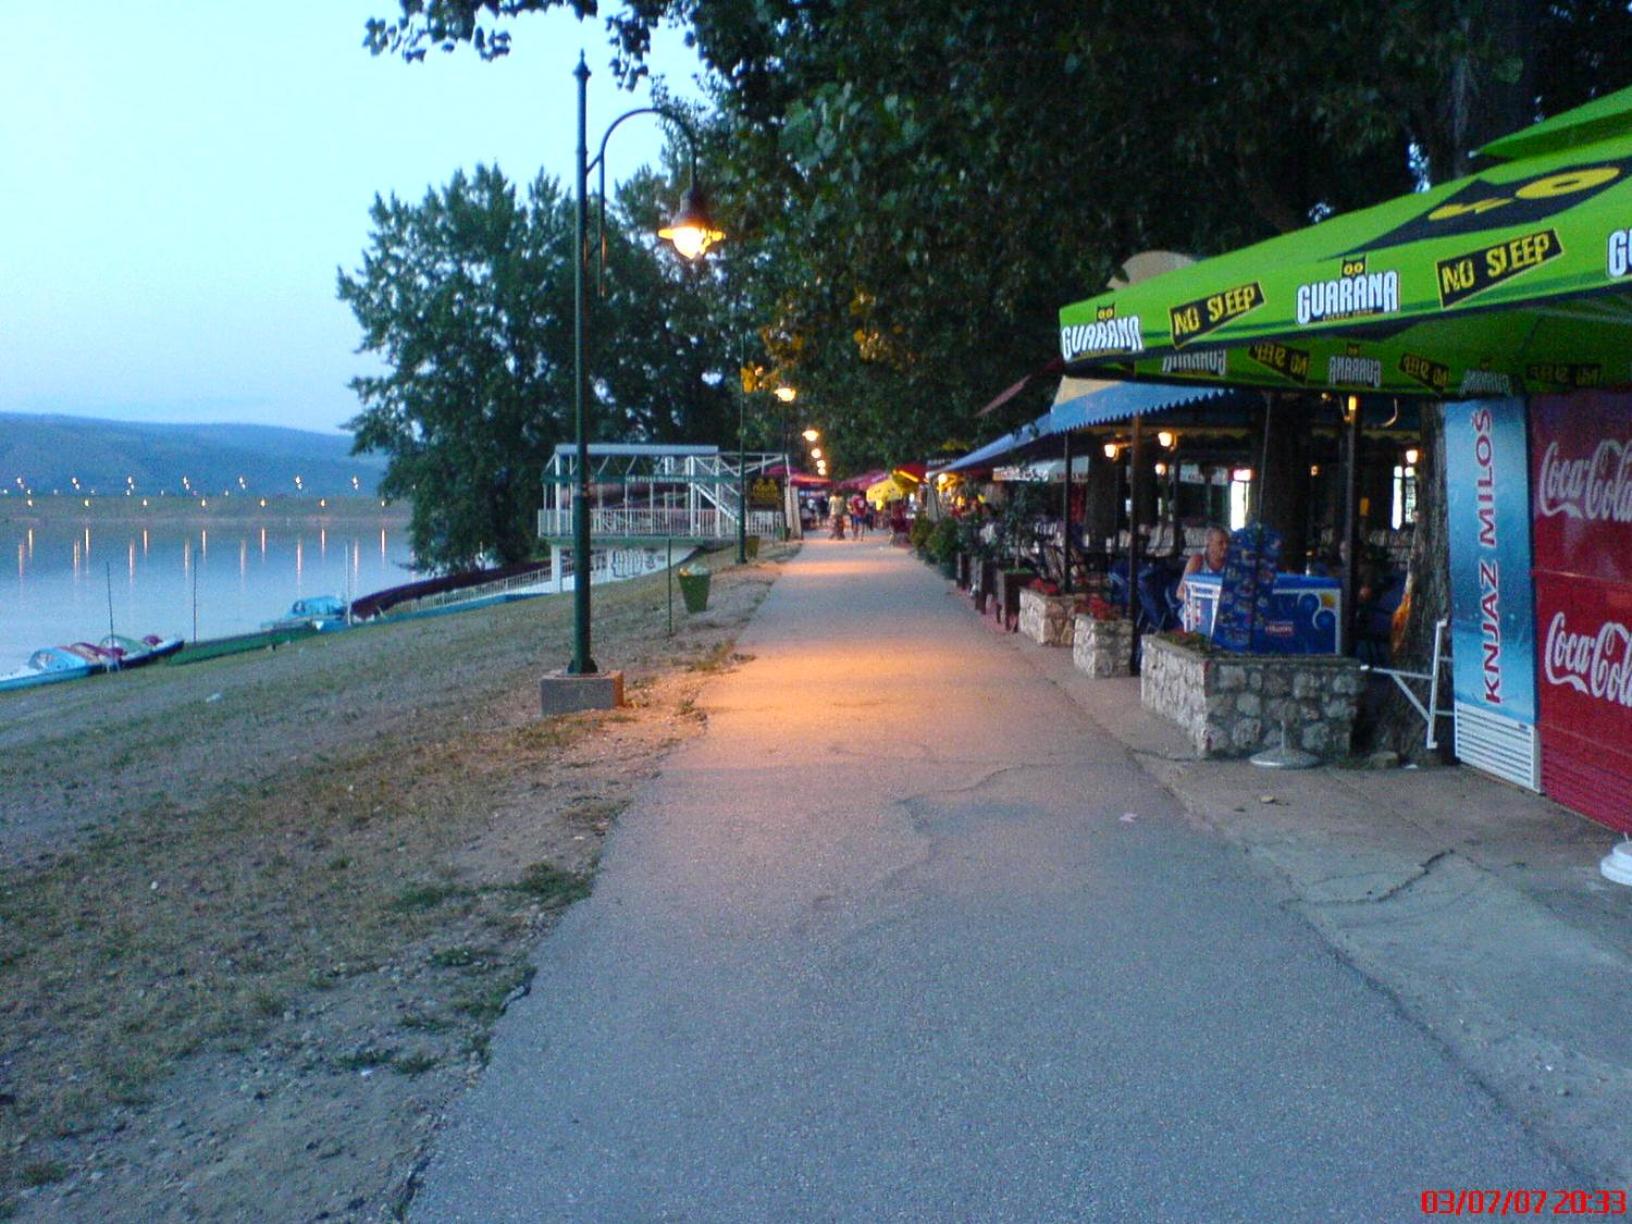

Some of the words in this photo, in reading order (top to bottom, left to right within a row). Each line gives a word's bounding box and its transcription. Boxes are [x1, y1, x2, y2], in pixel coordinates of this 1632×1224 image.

[1442, 259, 1475, 294] NO
[1486, 232, 1550, 278] SLEEP
[1173, 306, 1200, 336] NO
[1206, 285, 1255, 322] SLEEP
[1297, 269, 1398, 325] GUARANA
[1061, 315, 1143, 362] GUARANA
[1472, 409, 1496, 547] MILOŠ
[1481, 559, 1502, 704] KNJAZ
